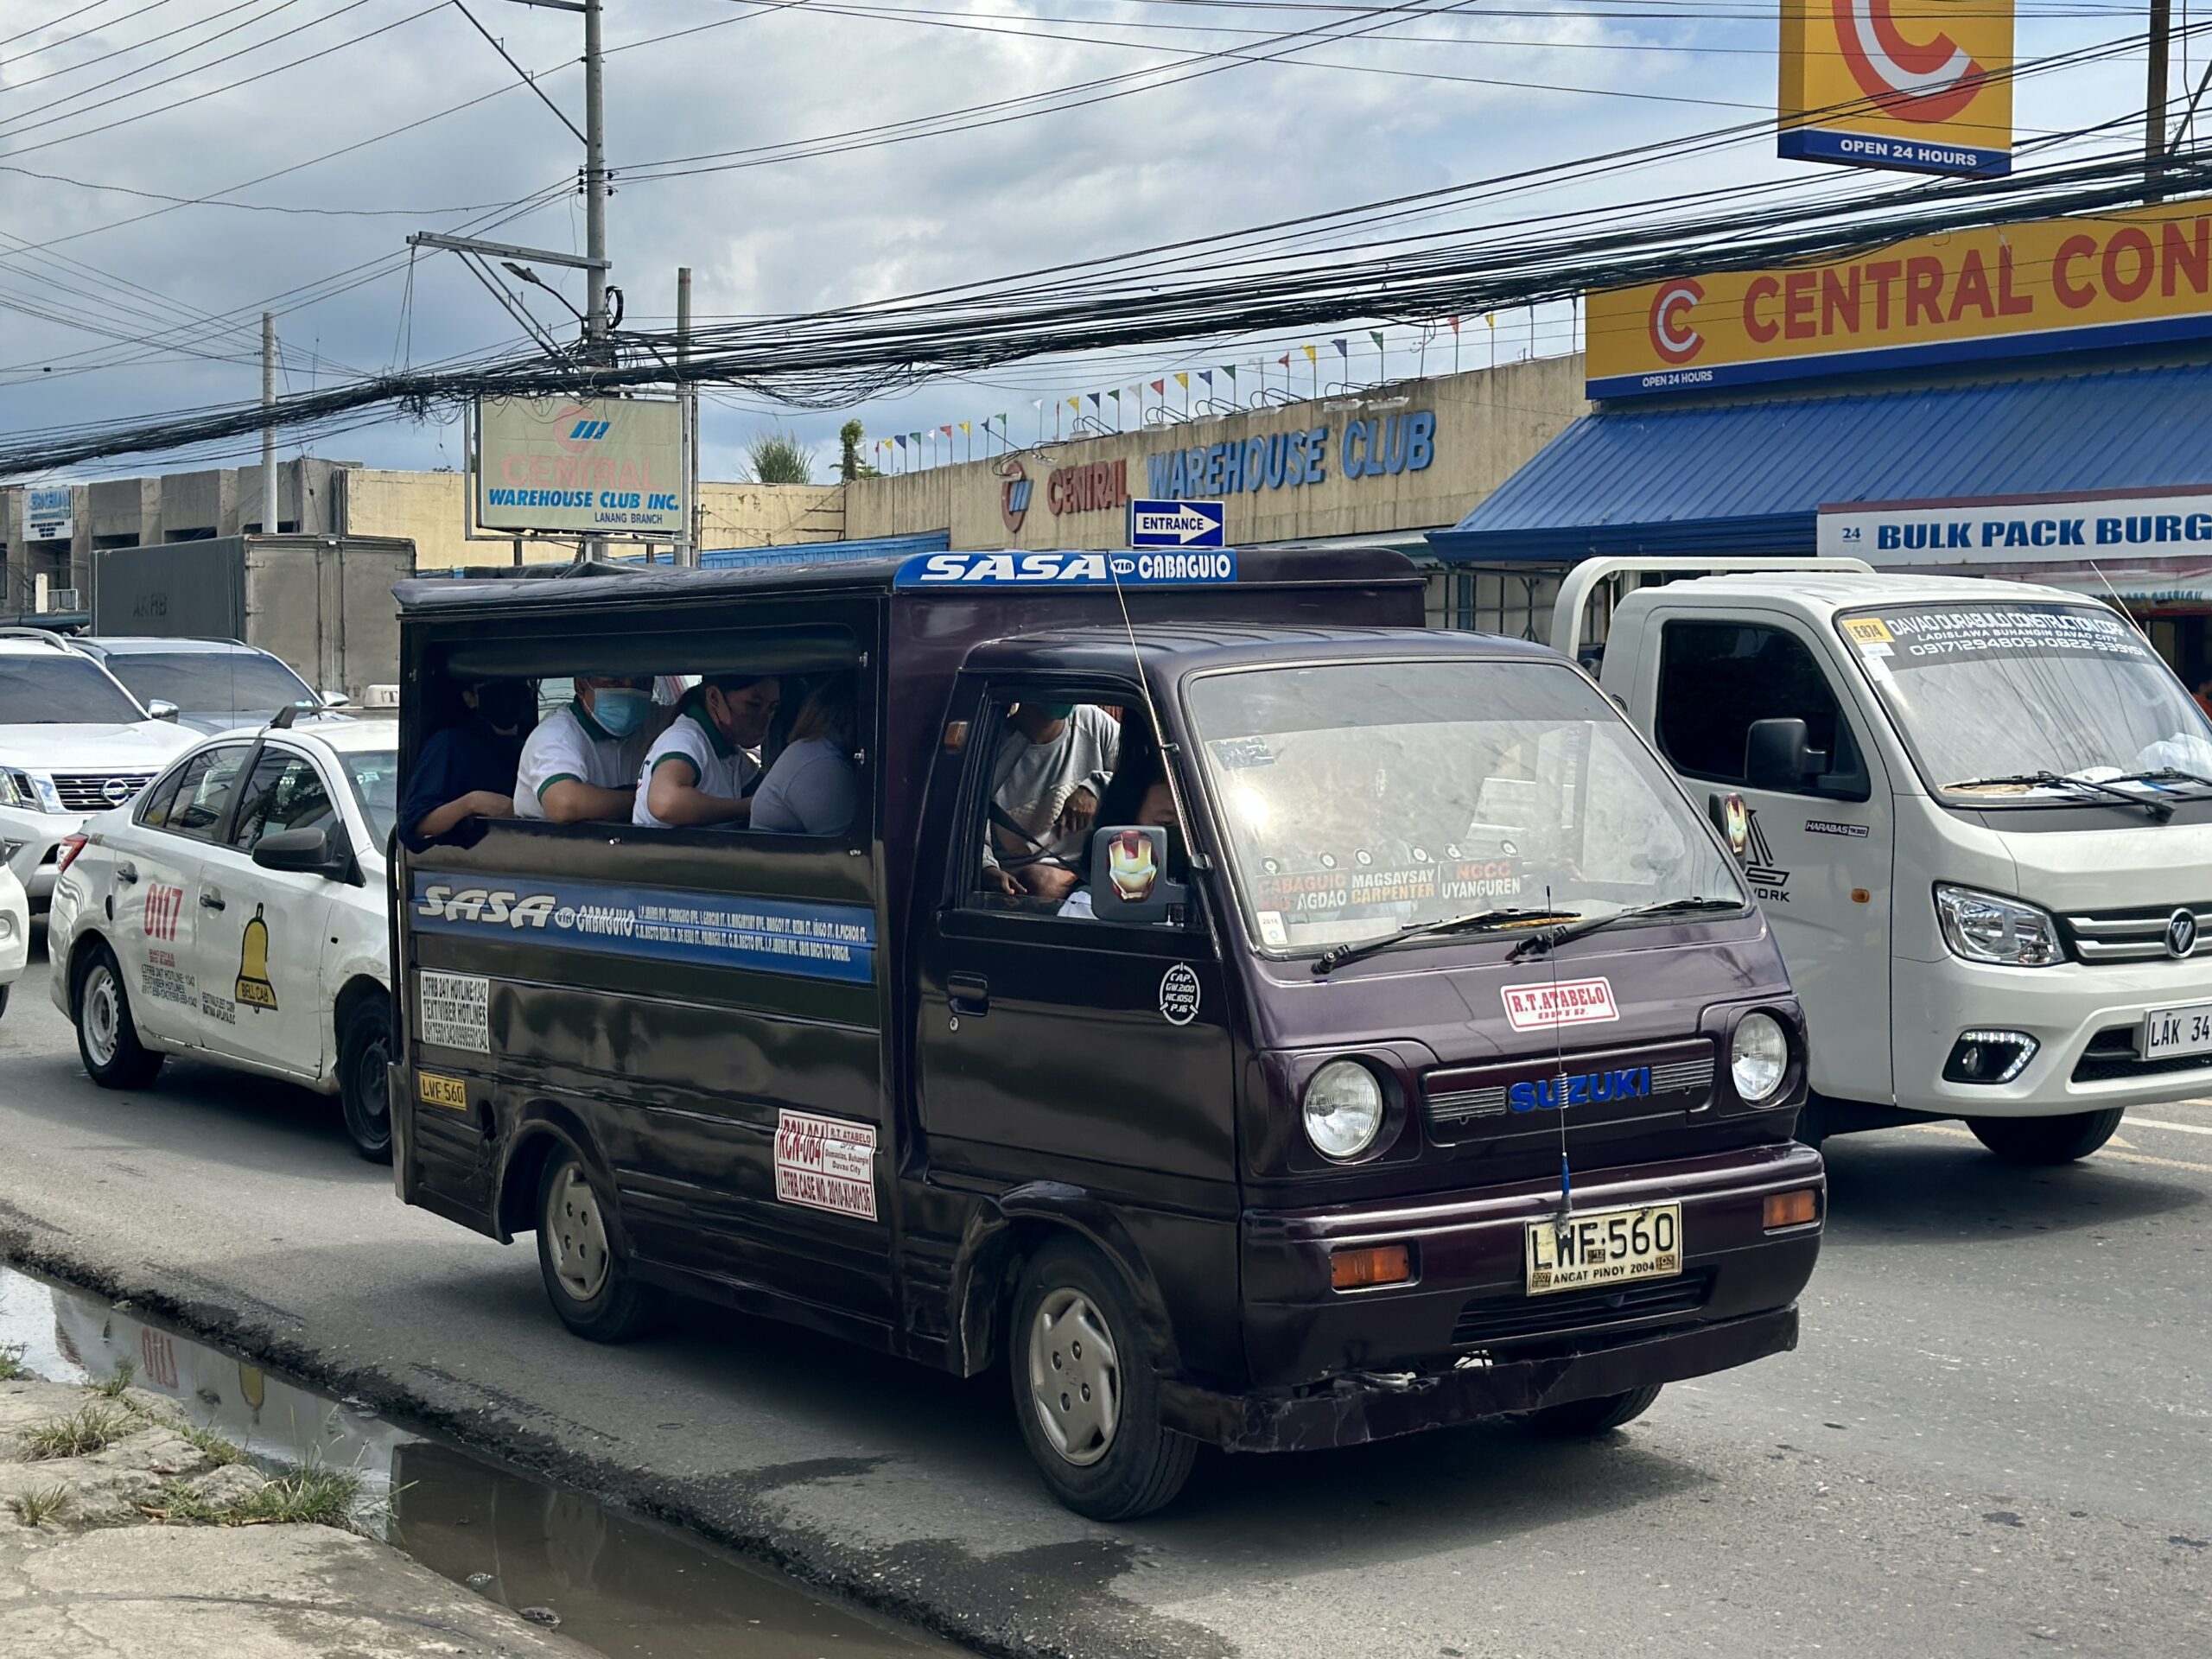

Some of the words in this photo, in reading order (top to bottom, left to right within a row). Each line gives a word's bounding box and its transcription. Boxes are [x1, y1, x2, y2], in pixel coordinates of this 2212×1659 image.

[1840, 139, 1888, 156] OPEN
[1892, 145, 1913, 158] 24
[1918, 149, 1977, 166] HOURS
[1742, 245, 2033, 344] CENTRAL
[2052, 217, 2212, 310] CON
[1642, 374, 1668, 387] OPEN
[1668, 373, 1680, 385] 24
[1681, 371, 1713, 384] HOURS
[501, 453, 664, 492] CENTRAL
[1046, 459, 1131, 517] CENTRAL
[1147, 424, 1329, 501] WAREHOUSE
[1342, 410, 1436, 480] CLUB
[488, 488, 594, 508] WAREHOUSE
[600, 491, 641, 510] CLUB
[647, 493, 679, 511] INC.
[594, 512, 627, 523] LANANG
[631, 512, 663, 524] BRANCH
[1142, 516, 1205, 531] ENTRANCE
[1842, 527, 1861, 539] 24
[1878, 522, 1973, 550] BULK
[1981, 518, 2087, 547] PACK
[2095, 512, 2212, 545] BURG
[920, 554, 1107, 582] SASA
[1113, 561, 1134, 573] VIA
[1138, 554, 1231, 579] CABAGUIO
[1885, 614, 1942, 636] DAVAO
[1936, 613, 2013, 632] DURABUILD
[1917, 628, 1990, 642] LADISLAWA
[1993, 628, 2053, 639] BUHANGIN
[2055, 629, 2094, 639] DAVAO
[2094, 633, 2118, 643] CITY
[1806, 821, 1849, 835] HARABAS
[1455, 862, 1511, 880] NCCC
[1258, 873, 1347, 895] CABAGUIO
[1351, 868, 1435, 888] MAGSAYSAY
[1441, 877, 1521, 899] UYANGUREN
[1754, 887, 1790, 903] ORK
[1296, 890, 1347, 911] AGDAO
[1351, 882, 1435, 905] CARPENTER
[143, 883, 183, 942] 0117
[419, 885, 557, 929] SASA
[576, 905, 636, 938] CABAGUIO
[1170, 973, 1192, 983] CAP.
[241, 982, 256, 1000] BELL
[256, 986, 269, 1003] CAB
[2150, 1018, 2182, 1047] LAK
[443, 1082, 464, 1104] 560
[1510, 1066, 1650, 1114] SUZUKI
[842, 1130, 871, 1144] ATABELO
[832, 1160, 849, 1172] Davao
[850, 1163, 861, 1175] City
[799, 1173, 816, 1201] CASE
[1592, 1264, 1625, 1279] PINOY
[1630, 1262, 1655, 1274] 2004
